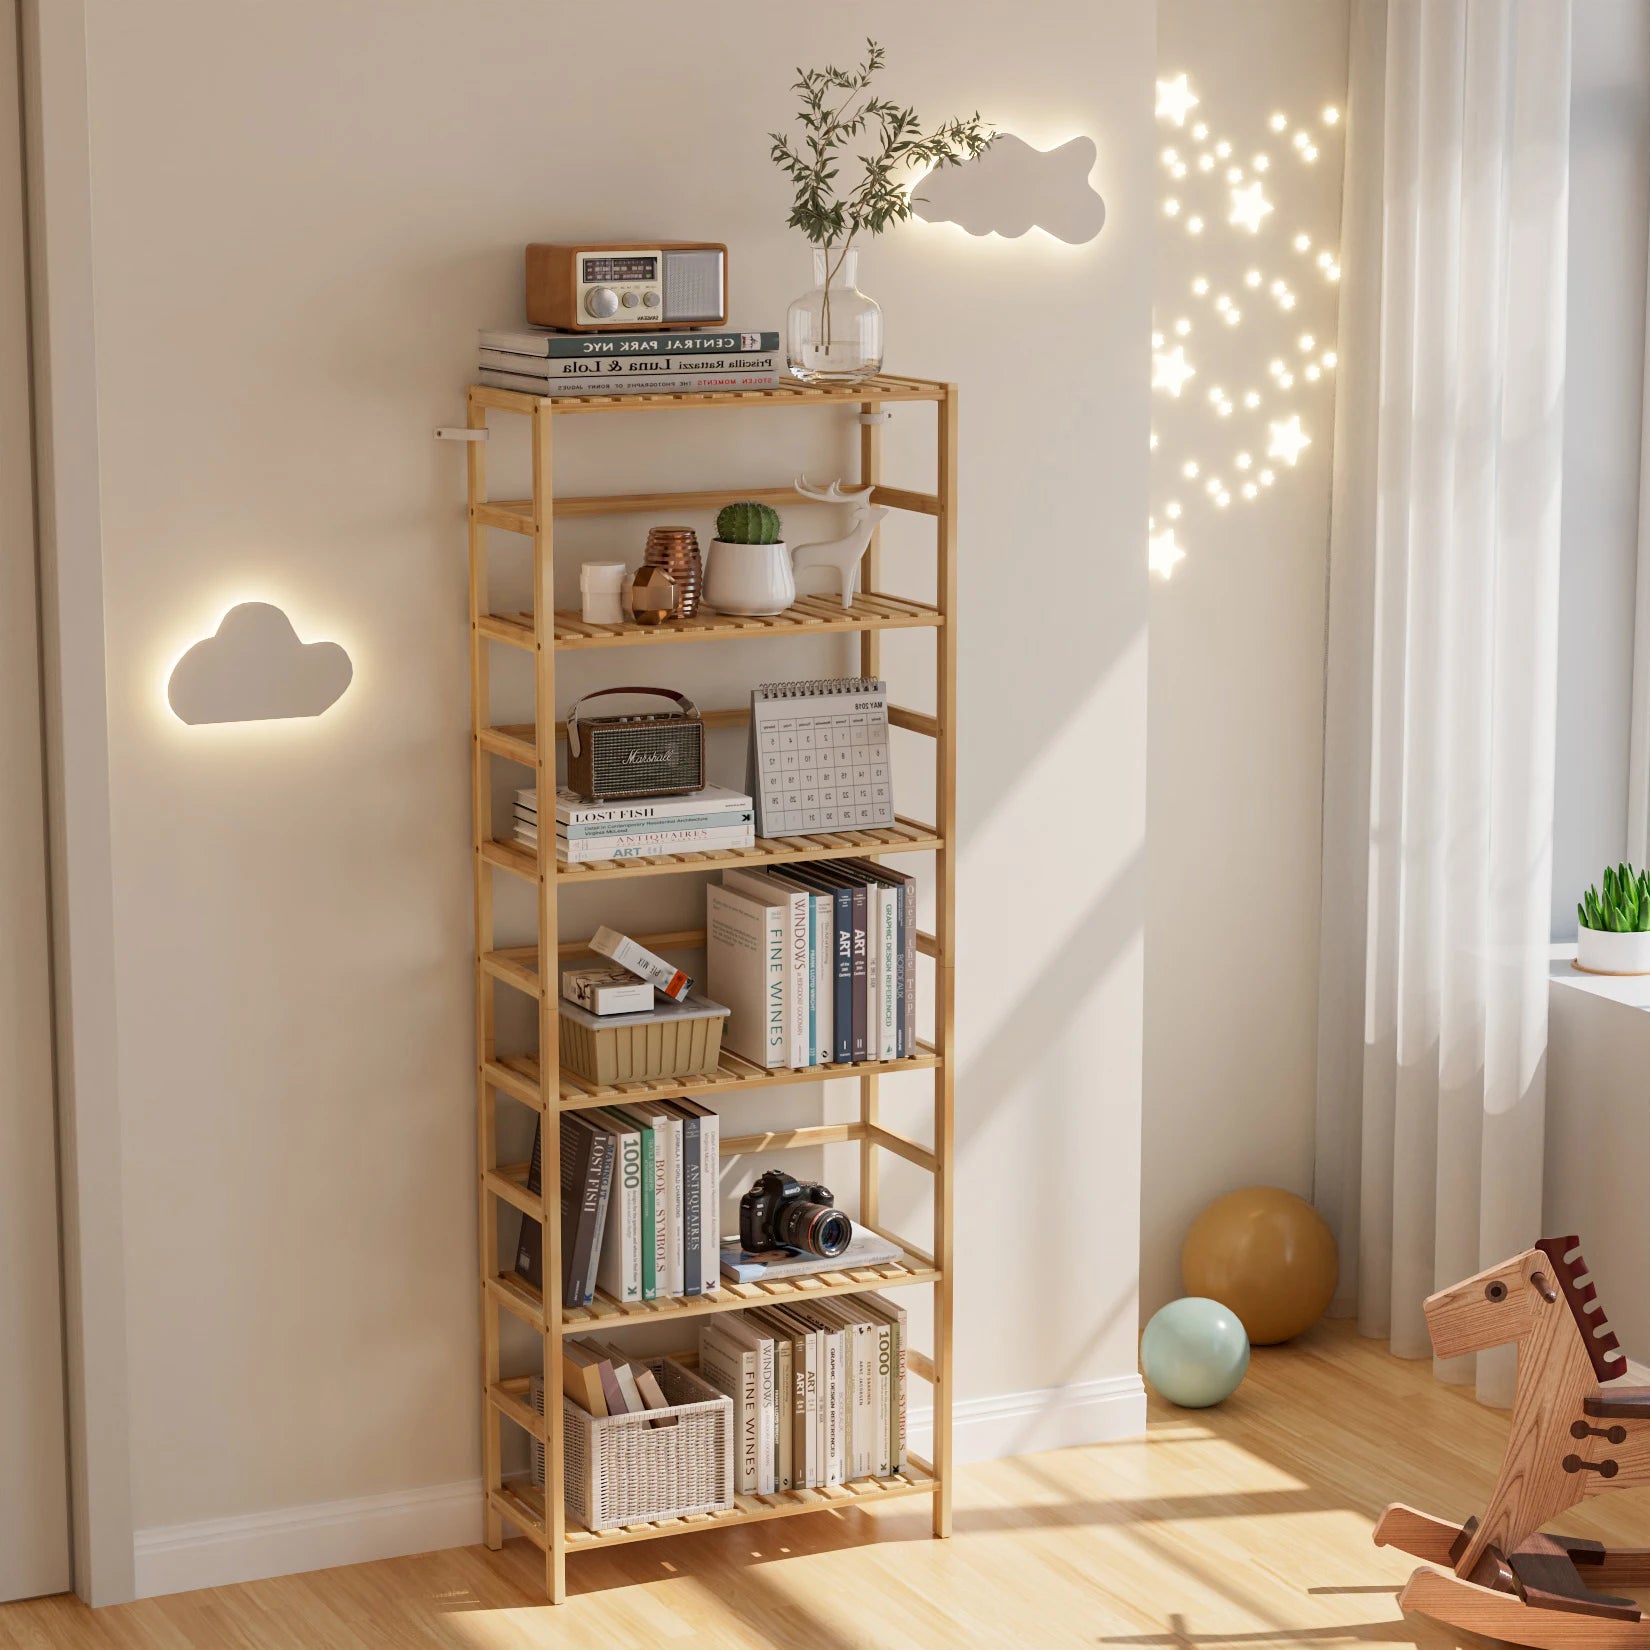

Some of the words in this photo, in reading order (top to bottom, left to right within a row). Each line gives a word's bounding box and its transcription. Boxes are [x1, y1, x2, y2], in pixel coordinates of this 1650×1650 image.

[622, 749, 674, 765] Marshall
[575, 811, 616, 823] LOST
[620, 808, 654, 819] FISH
[613, 847, 642, 858] ART
[616, 829, 708, 843] ANTIQUAIRES
[907, 885, 915, 926] Over
[770, 929, 783, 972] FINE
[794, 898, 806, 970] WINDOWS
[839, 930, 851, 957] ART
[854, 929, 866, 956] ART
[770, 981, 783, 1046] WINES
[590, 1136, 607, 1176] LOST
[601, 1144, 614, 1186] MAKING
[623, 1139, 640, 1189] 1000
[583, 1179, 600, 1212] FISH
[656, 1160, 665, 1195] BOOK
[690, 1164, 700, 1250] ANTIQUAIRES
[656, 1209, 665, 1273] SYMBOLS
[879, 1331, 889, 1376] 1000
[745, 1371, 755, 1410] FINE
[763, 1344, 772, 1409] WINDOWS
[796, 1372, 805, 1396] ART
[807, 1371, 815, 1394] ART
[745, 1417, 755, 1476] WINES
